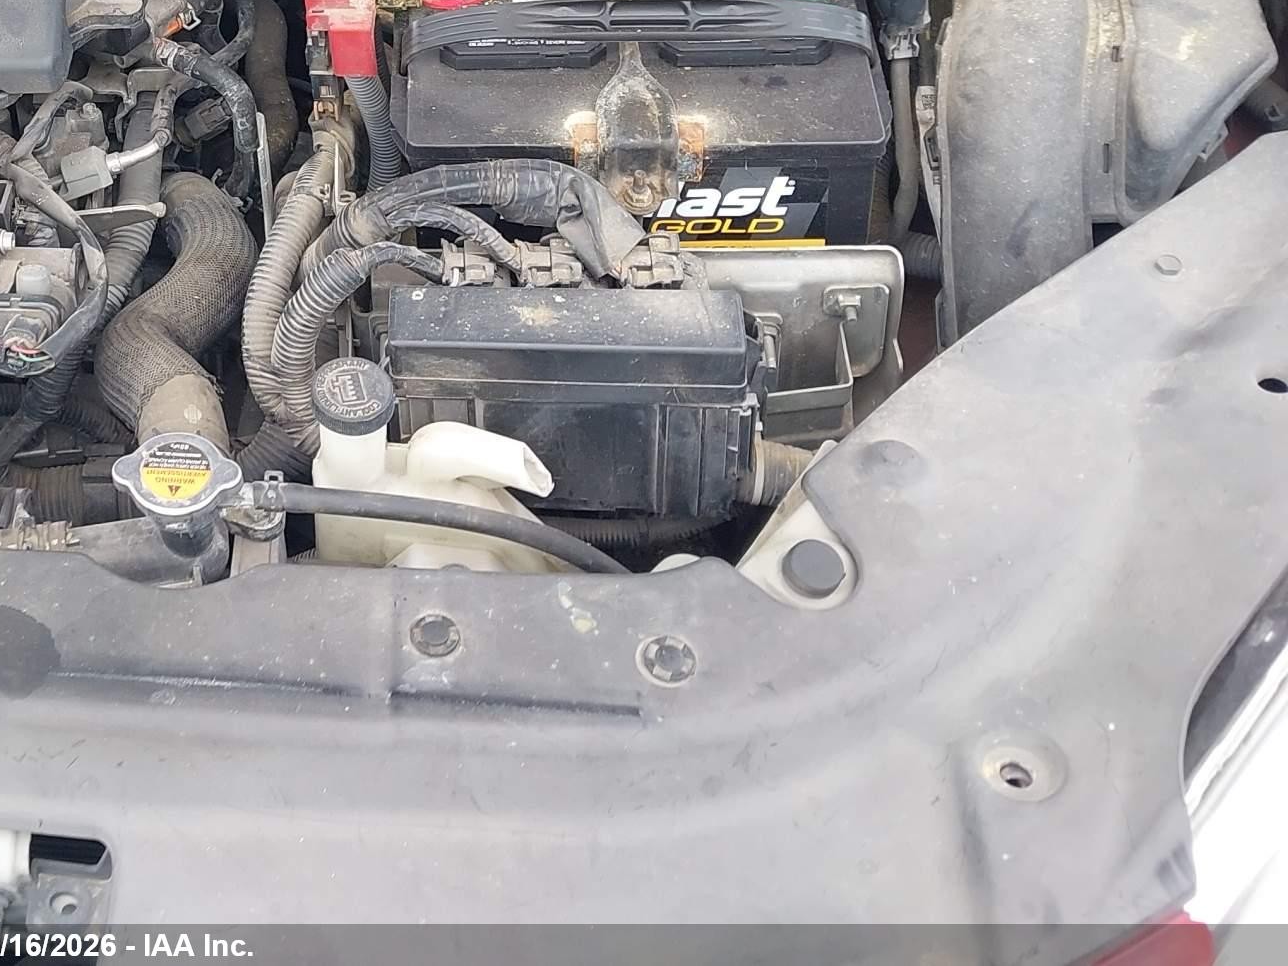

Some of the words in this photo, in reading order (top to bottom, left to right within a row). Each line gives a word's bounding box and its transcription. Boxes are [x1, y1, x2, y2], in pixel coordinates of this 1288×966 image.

[656, 176, 796, 218] last
[650, 218, 785, 234] GOLD
[155, 476, 196, 485] WARNING
